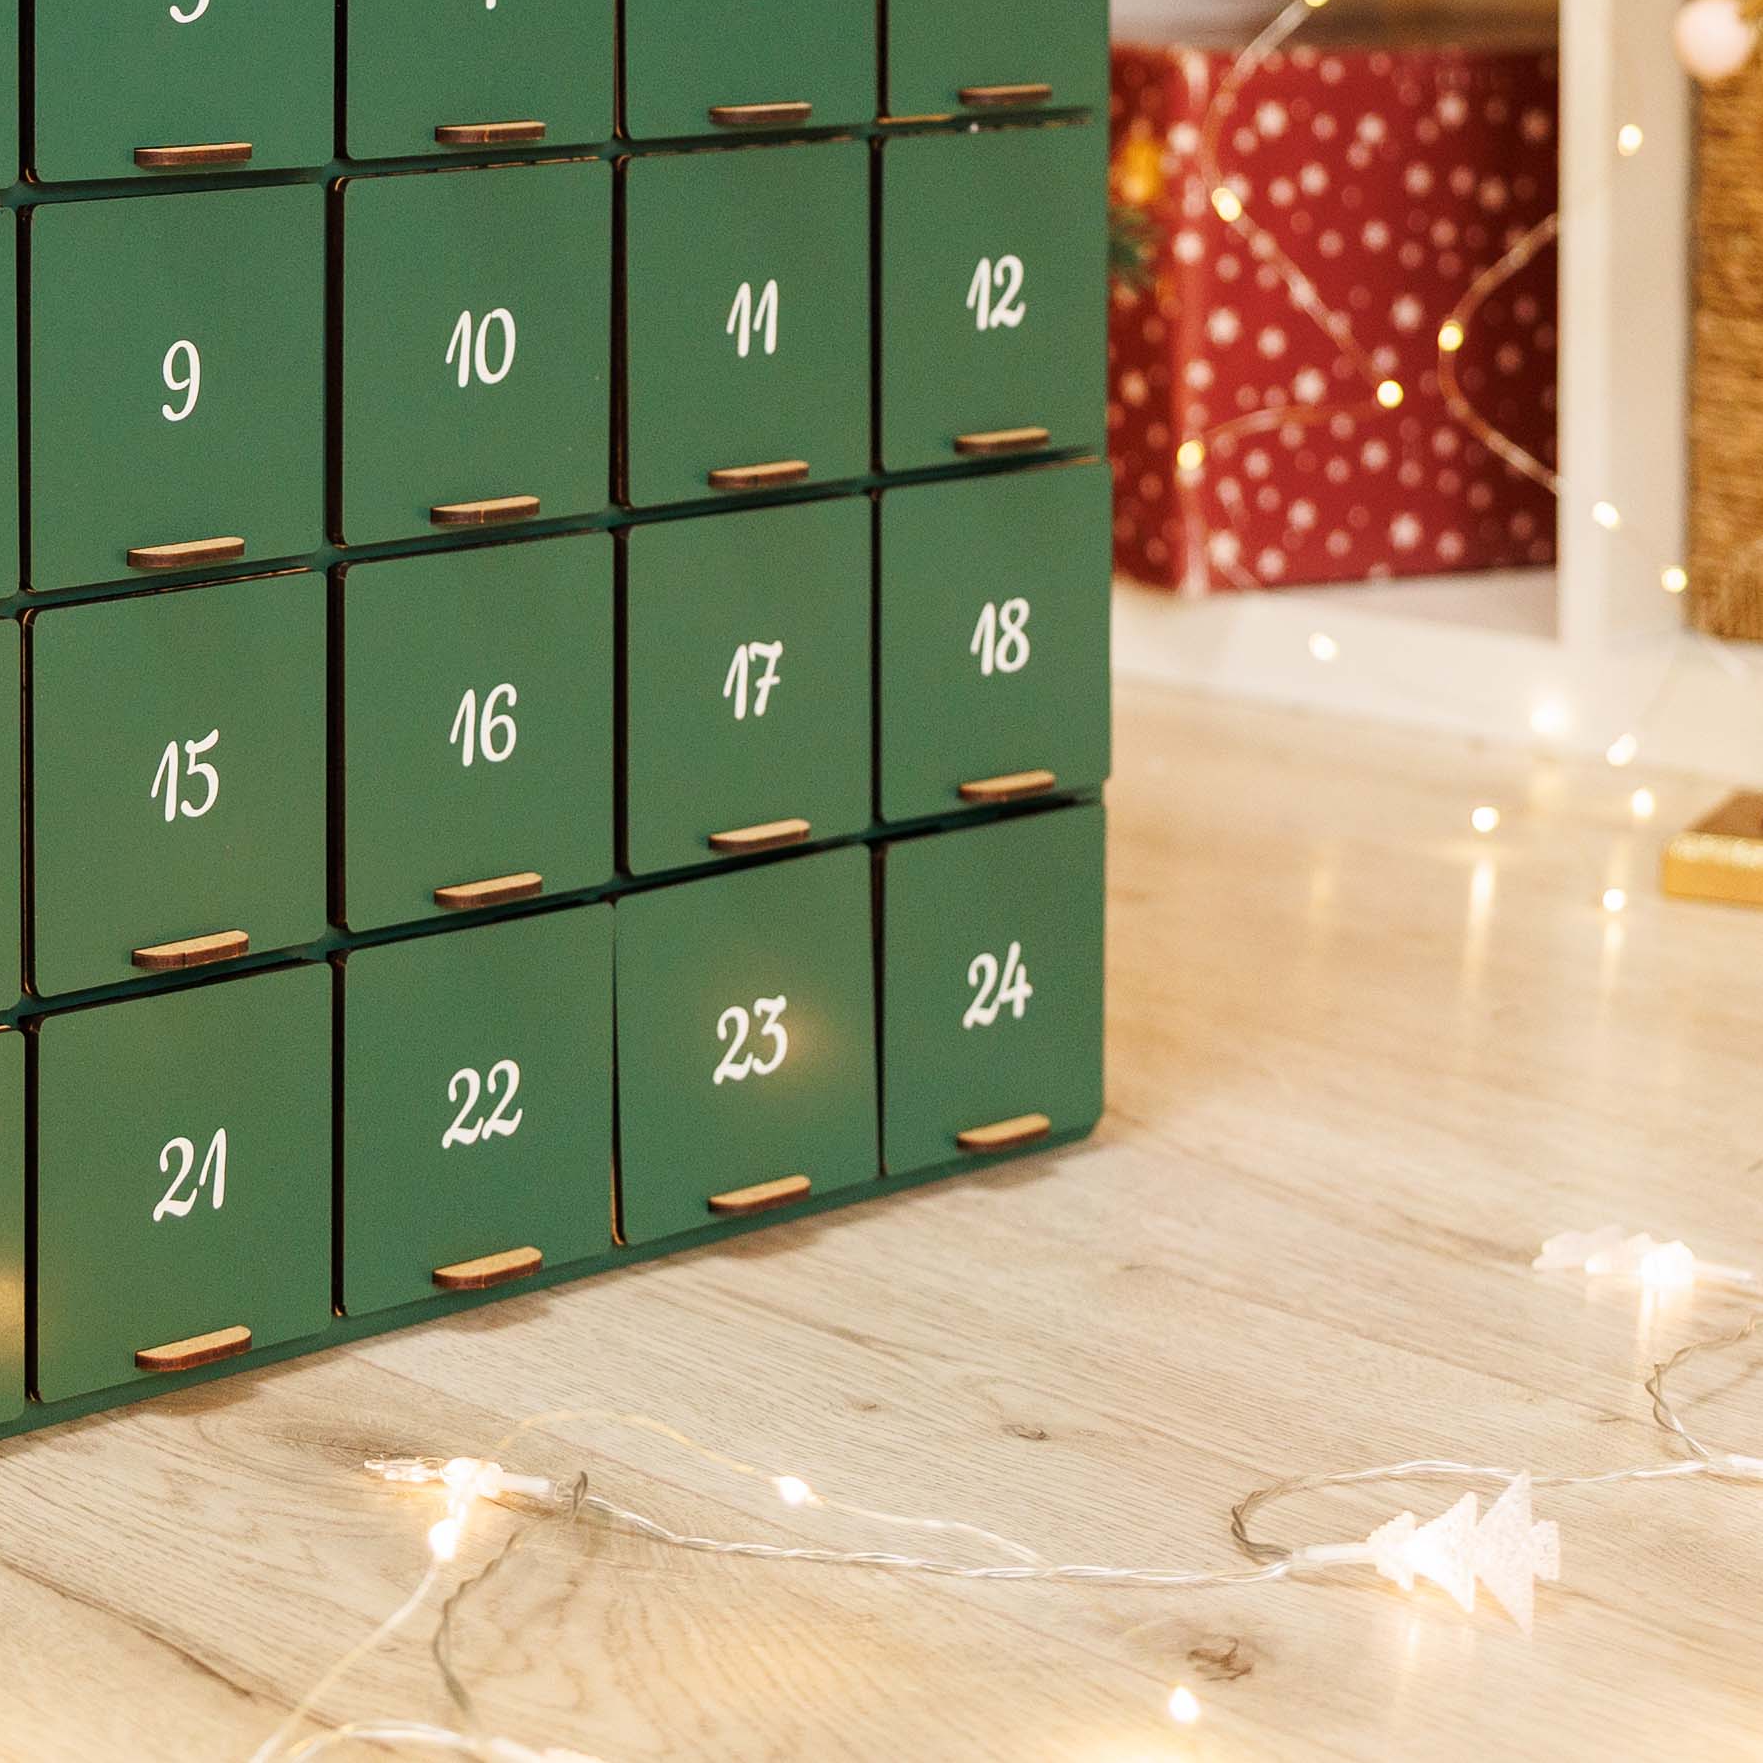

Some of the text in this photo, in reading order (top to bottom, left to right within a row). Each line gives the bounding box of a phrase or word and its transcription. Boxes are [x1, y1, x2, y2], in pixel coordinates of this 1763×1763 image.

[726, 279, 778, 358] 11
[966, 255, 1026, 331] 12
[162, 339, 201, 422] 9
[445, 307, 516, 388] 10
[970, 597, 1030, 676] 18
[722, 640, 783, 720] 17
[449, 683, 518, 767] 16
[150, 728, 219, 822] 15
[963, 941, 1033, 1029] 24
[712, 995, 788, 1085] 23
[441, 1059, 523, 1149] 22
[152, 1127, 227, 1222] 21
